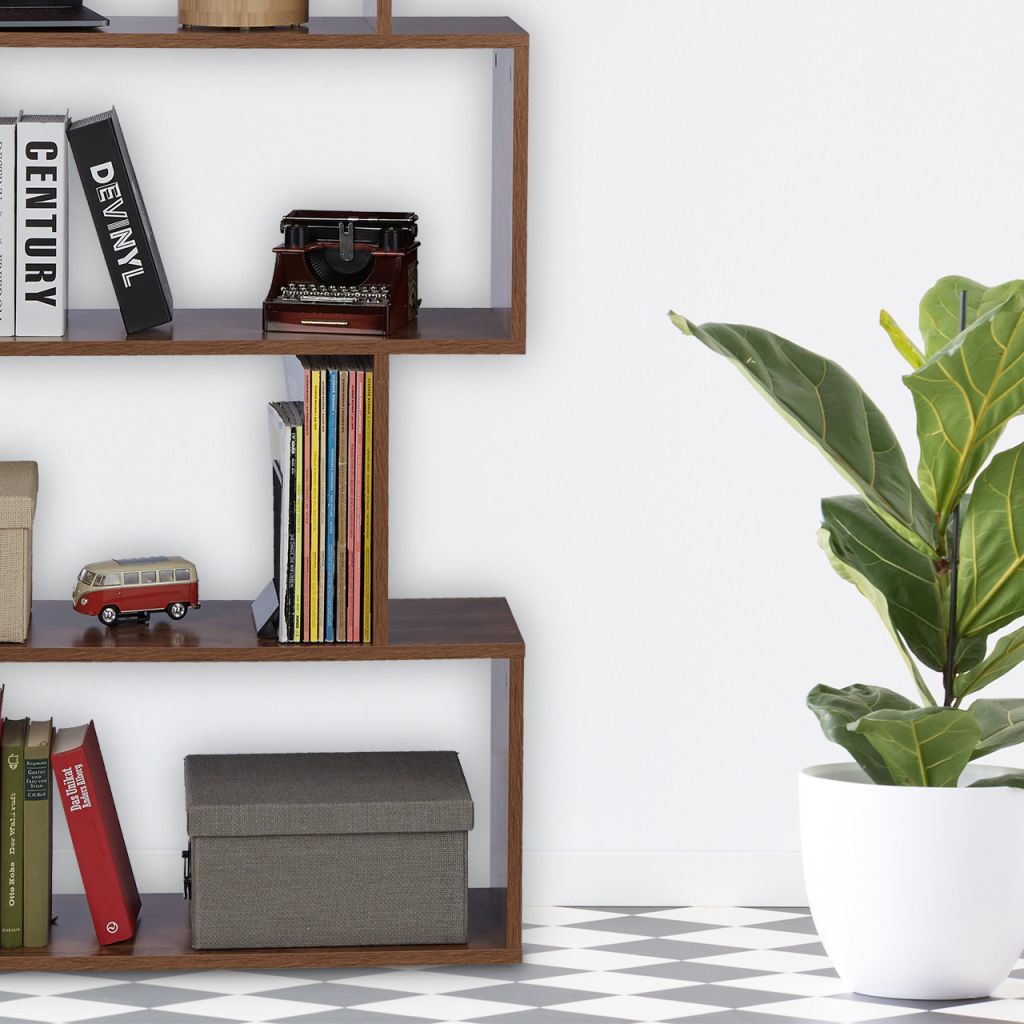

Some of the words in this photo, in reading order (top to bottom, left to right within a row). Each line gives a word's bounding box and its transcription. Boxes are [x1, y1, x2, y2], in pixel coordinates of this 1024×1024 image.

[24, 141, 59, 307] CENTURY
[89, 161, 145, 289] DEVINYL
[62, 766, 78, 796] Unikat
[70, 795, 82, 812] Das
[80, 785, 92, 809] Anders
